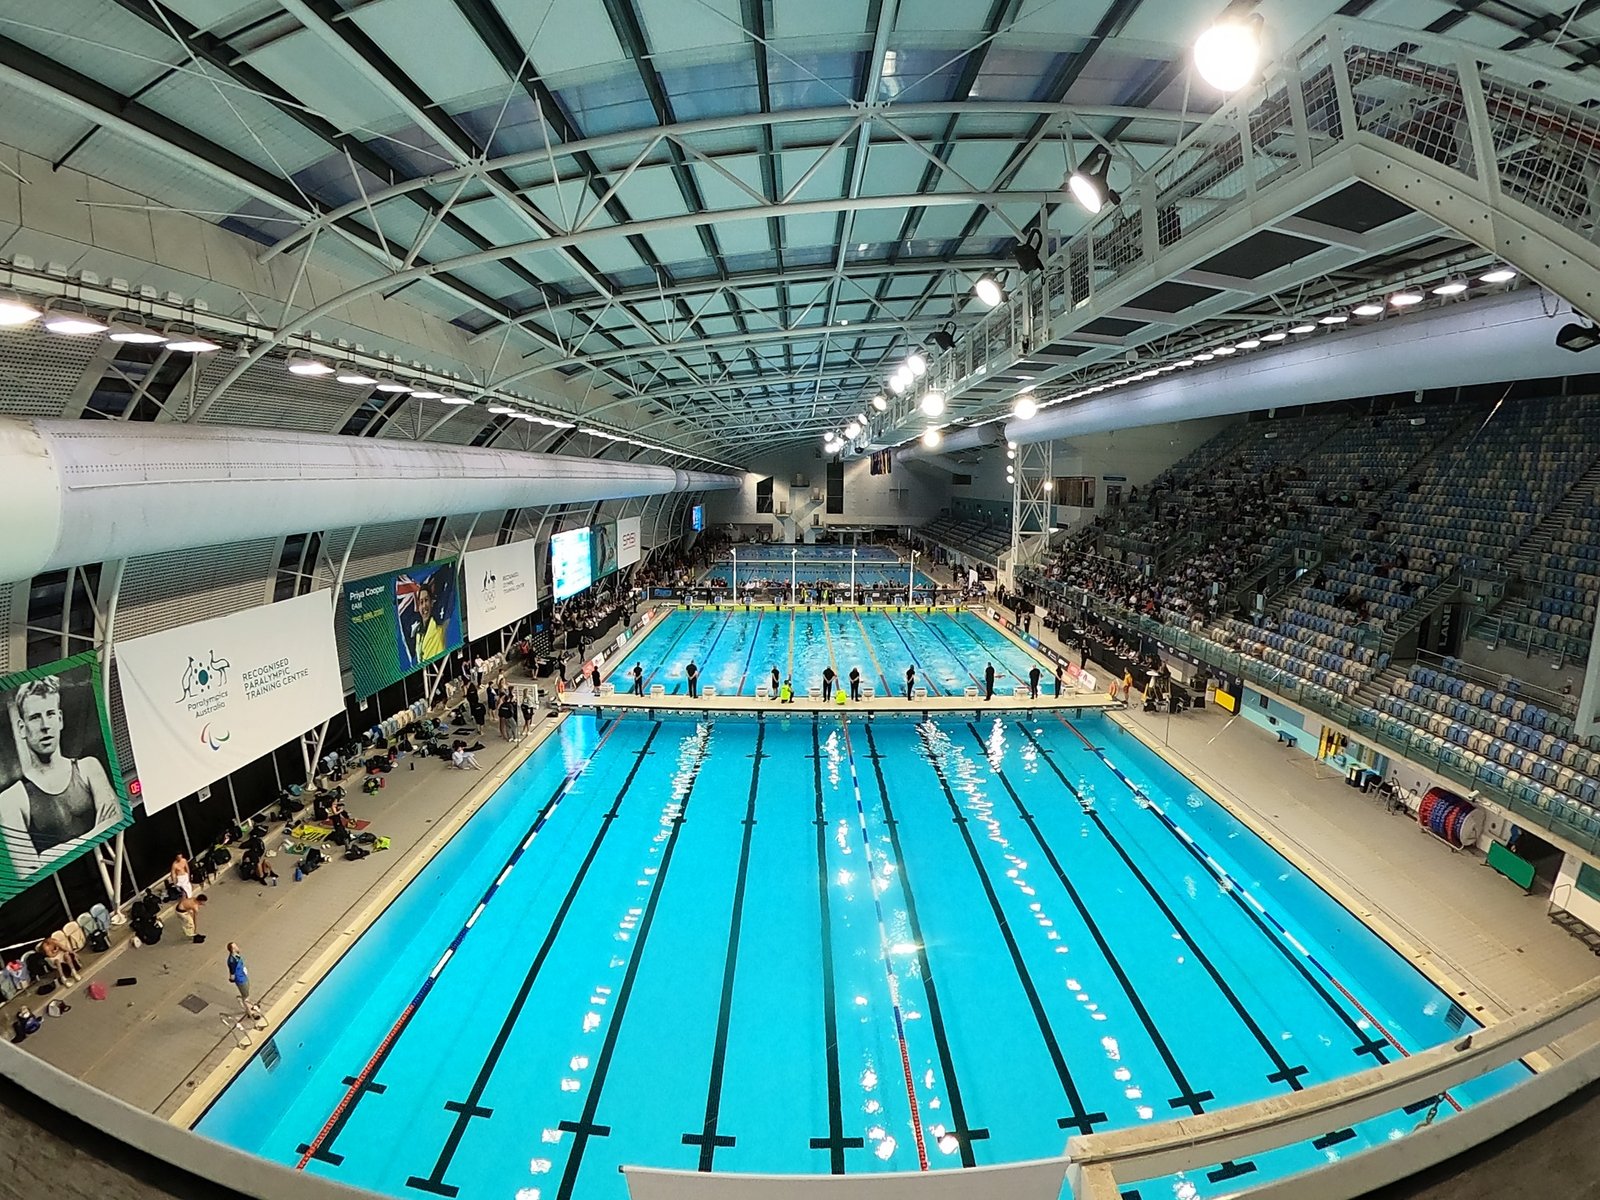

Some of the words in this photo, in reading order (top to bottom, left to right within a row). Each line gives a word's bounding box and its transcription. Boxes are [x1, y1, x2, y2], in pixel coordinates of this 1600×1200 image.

[365, 585, 385, 597] Cooper
[1438, 604, 1452, 647] LANE
[241, 657, 290, 682] RECOGNISED
[243, 666, 291, 692] PARALYMPIC
[245, 679, 281, 700] TRAINING
[282, 668, 309, 686] CENTRE
[187, 690, 229, 712] Paralympics
[195, 701, 226, 719] Australia
